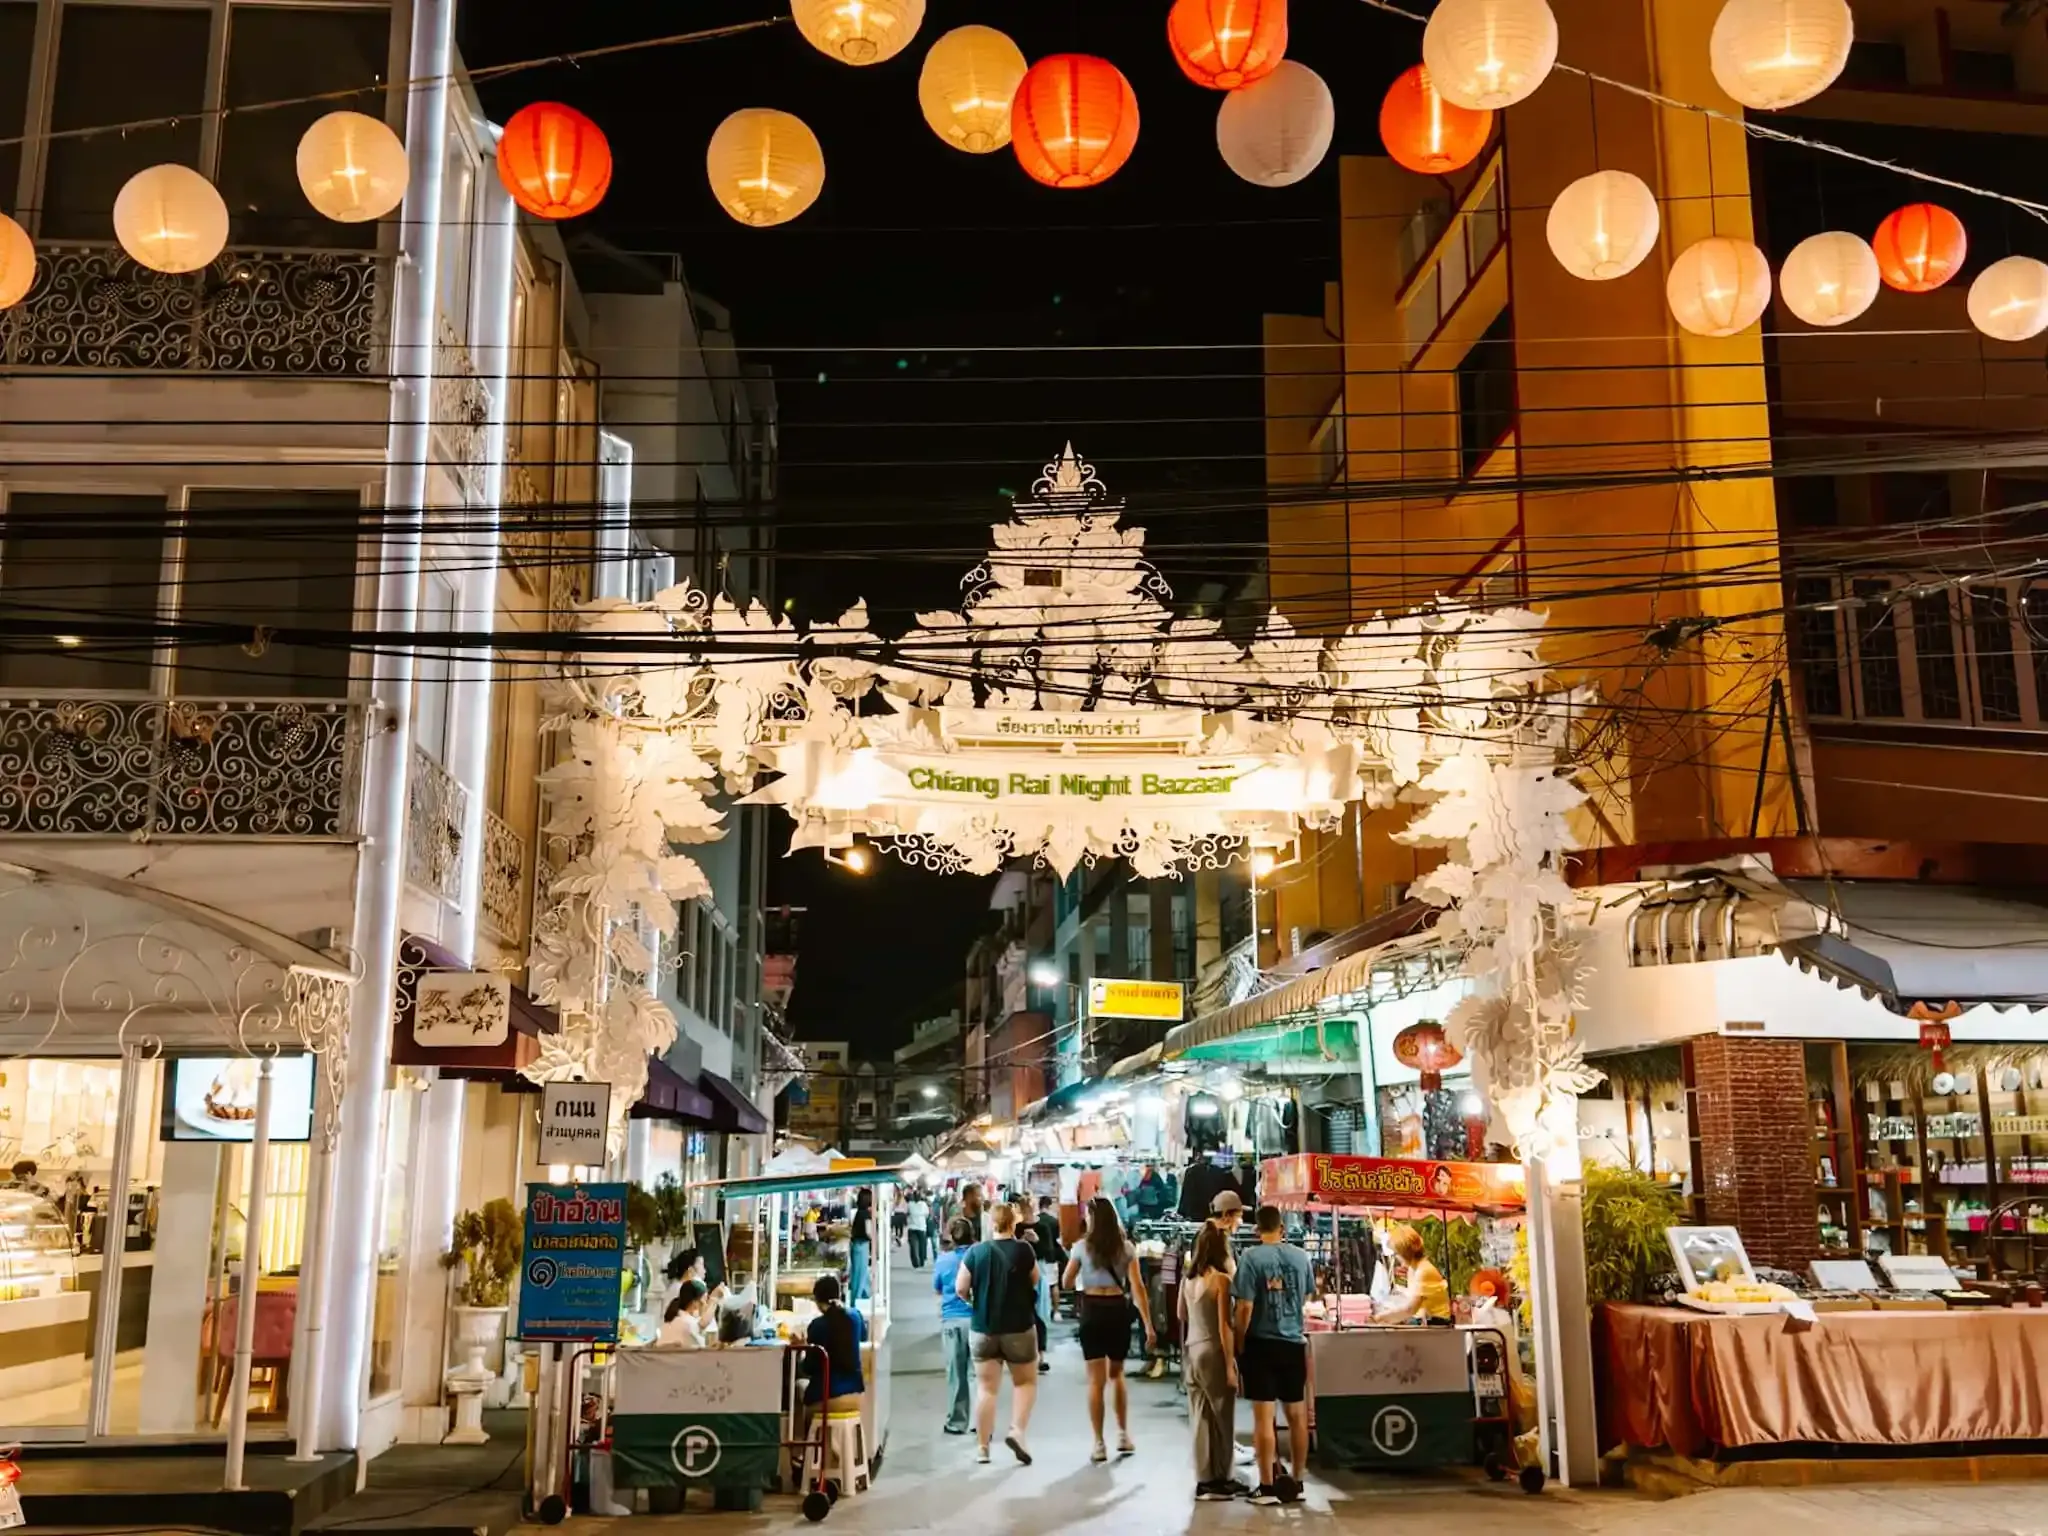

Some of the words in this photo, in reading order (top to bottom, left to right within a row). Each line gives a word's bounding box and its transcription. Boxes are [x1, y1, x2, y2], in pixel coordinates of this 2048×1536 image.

[908, 767, 999, 799] Chiang
[1009, 773, 1050, 795] Rai
[1060, 774, 1132, 801] Night
[1142, 773, 1237, 794] Bazaar
[555, 1100, 596, 1118] ถนน
[545, 1124, 601, 1142] ส่วนบุคคล
[1315, 1156, 1426, 1195] โรตีหนีผัว
[532, 1189, 623, 1225] ป้าอ้วน
[1384, 1415, 1407, 1447] P
[685, 1435, 709, 1467] P
